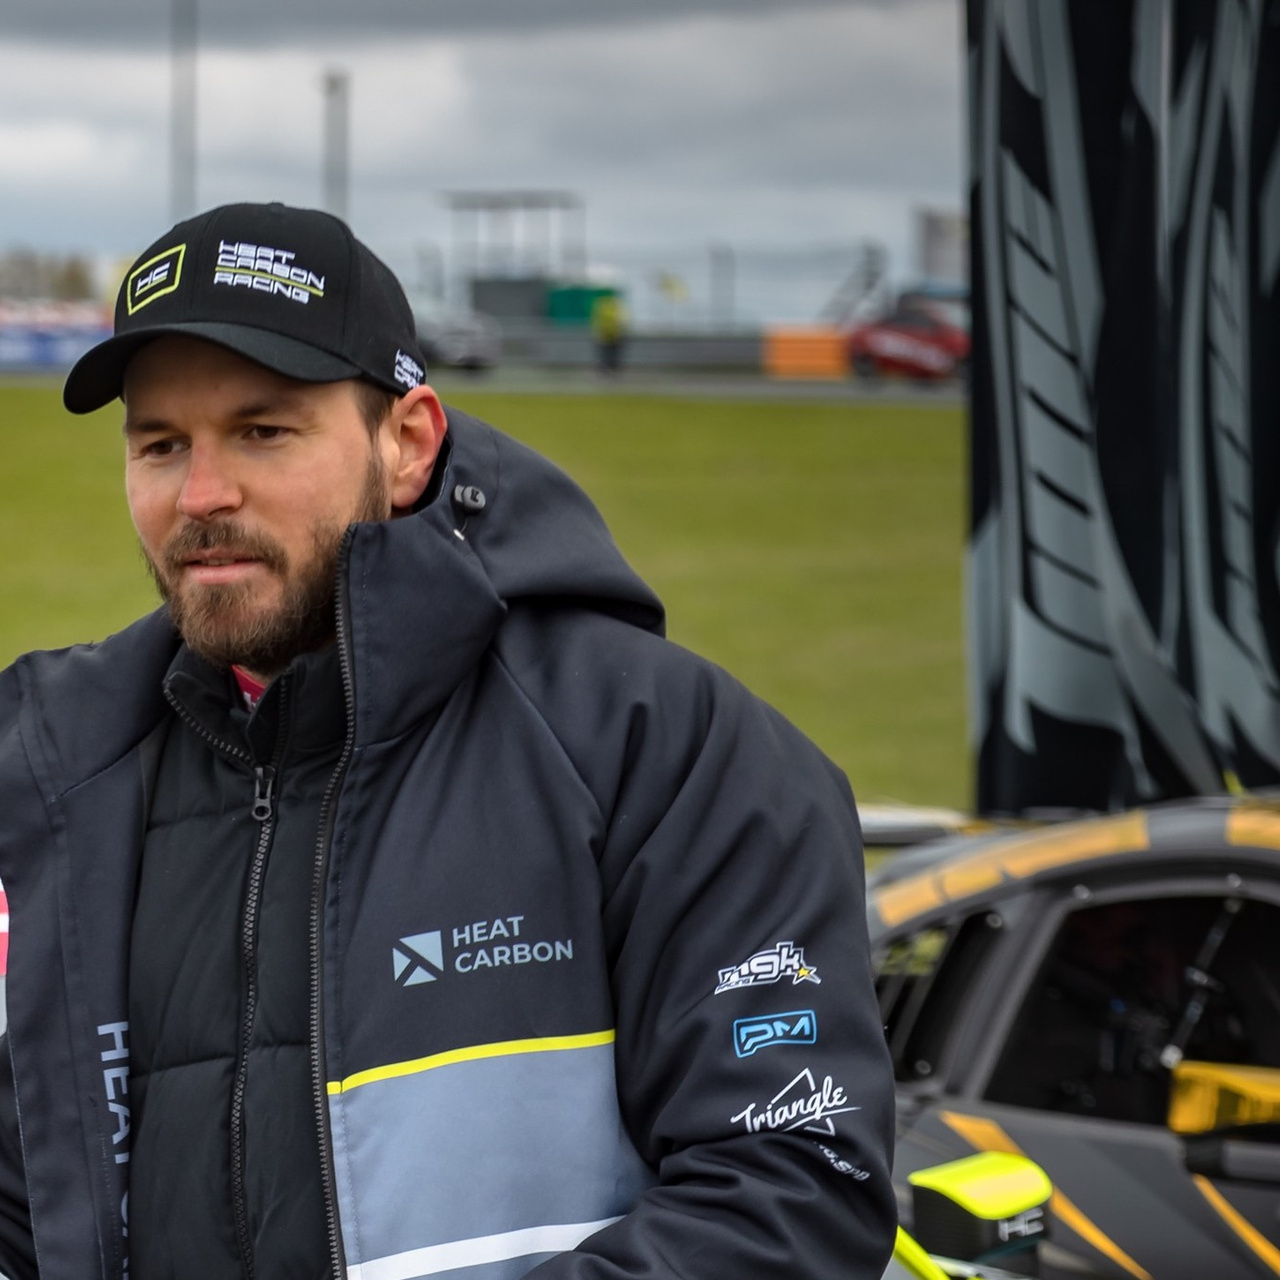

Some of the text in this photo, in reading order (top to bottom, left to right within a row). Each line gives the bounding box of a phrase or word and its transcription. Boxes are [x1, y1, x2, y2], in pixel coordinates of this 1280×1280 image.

[219, 240, 296, 264] HEAT
[213, 272, 310, 304] RACING
[217, 253, 325, 290] CARBON
[452, 915, 524, 948] HEAT
[454, 939, 574, 973] CARBON
[97, 1021, 129, 1165] HEA
[730, 1075, 848, 1134] Triangle
[998, 1207, 1044, 1241] HC
